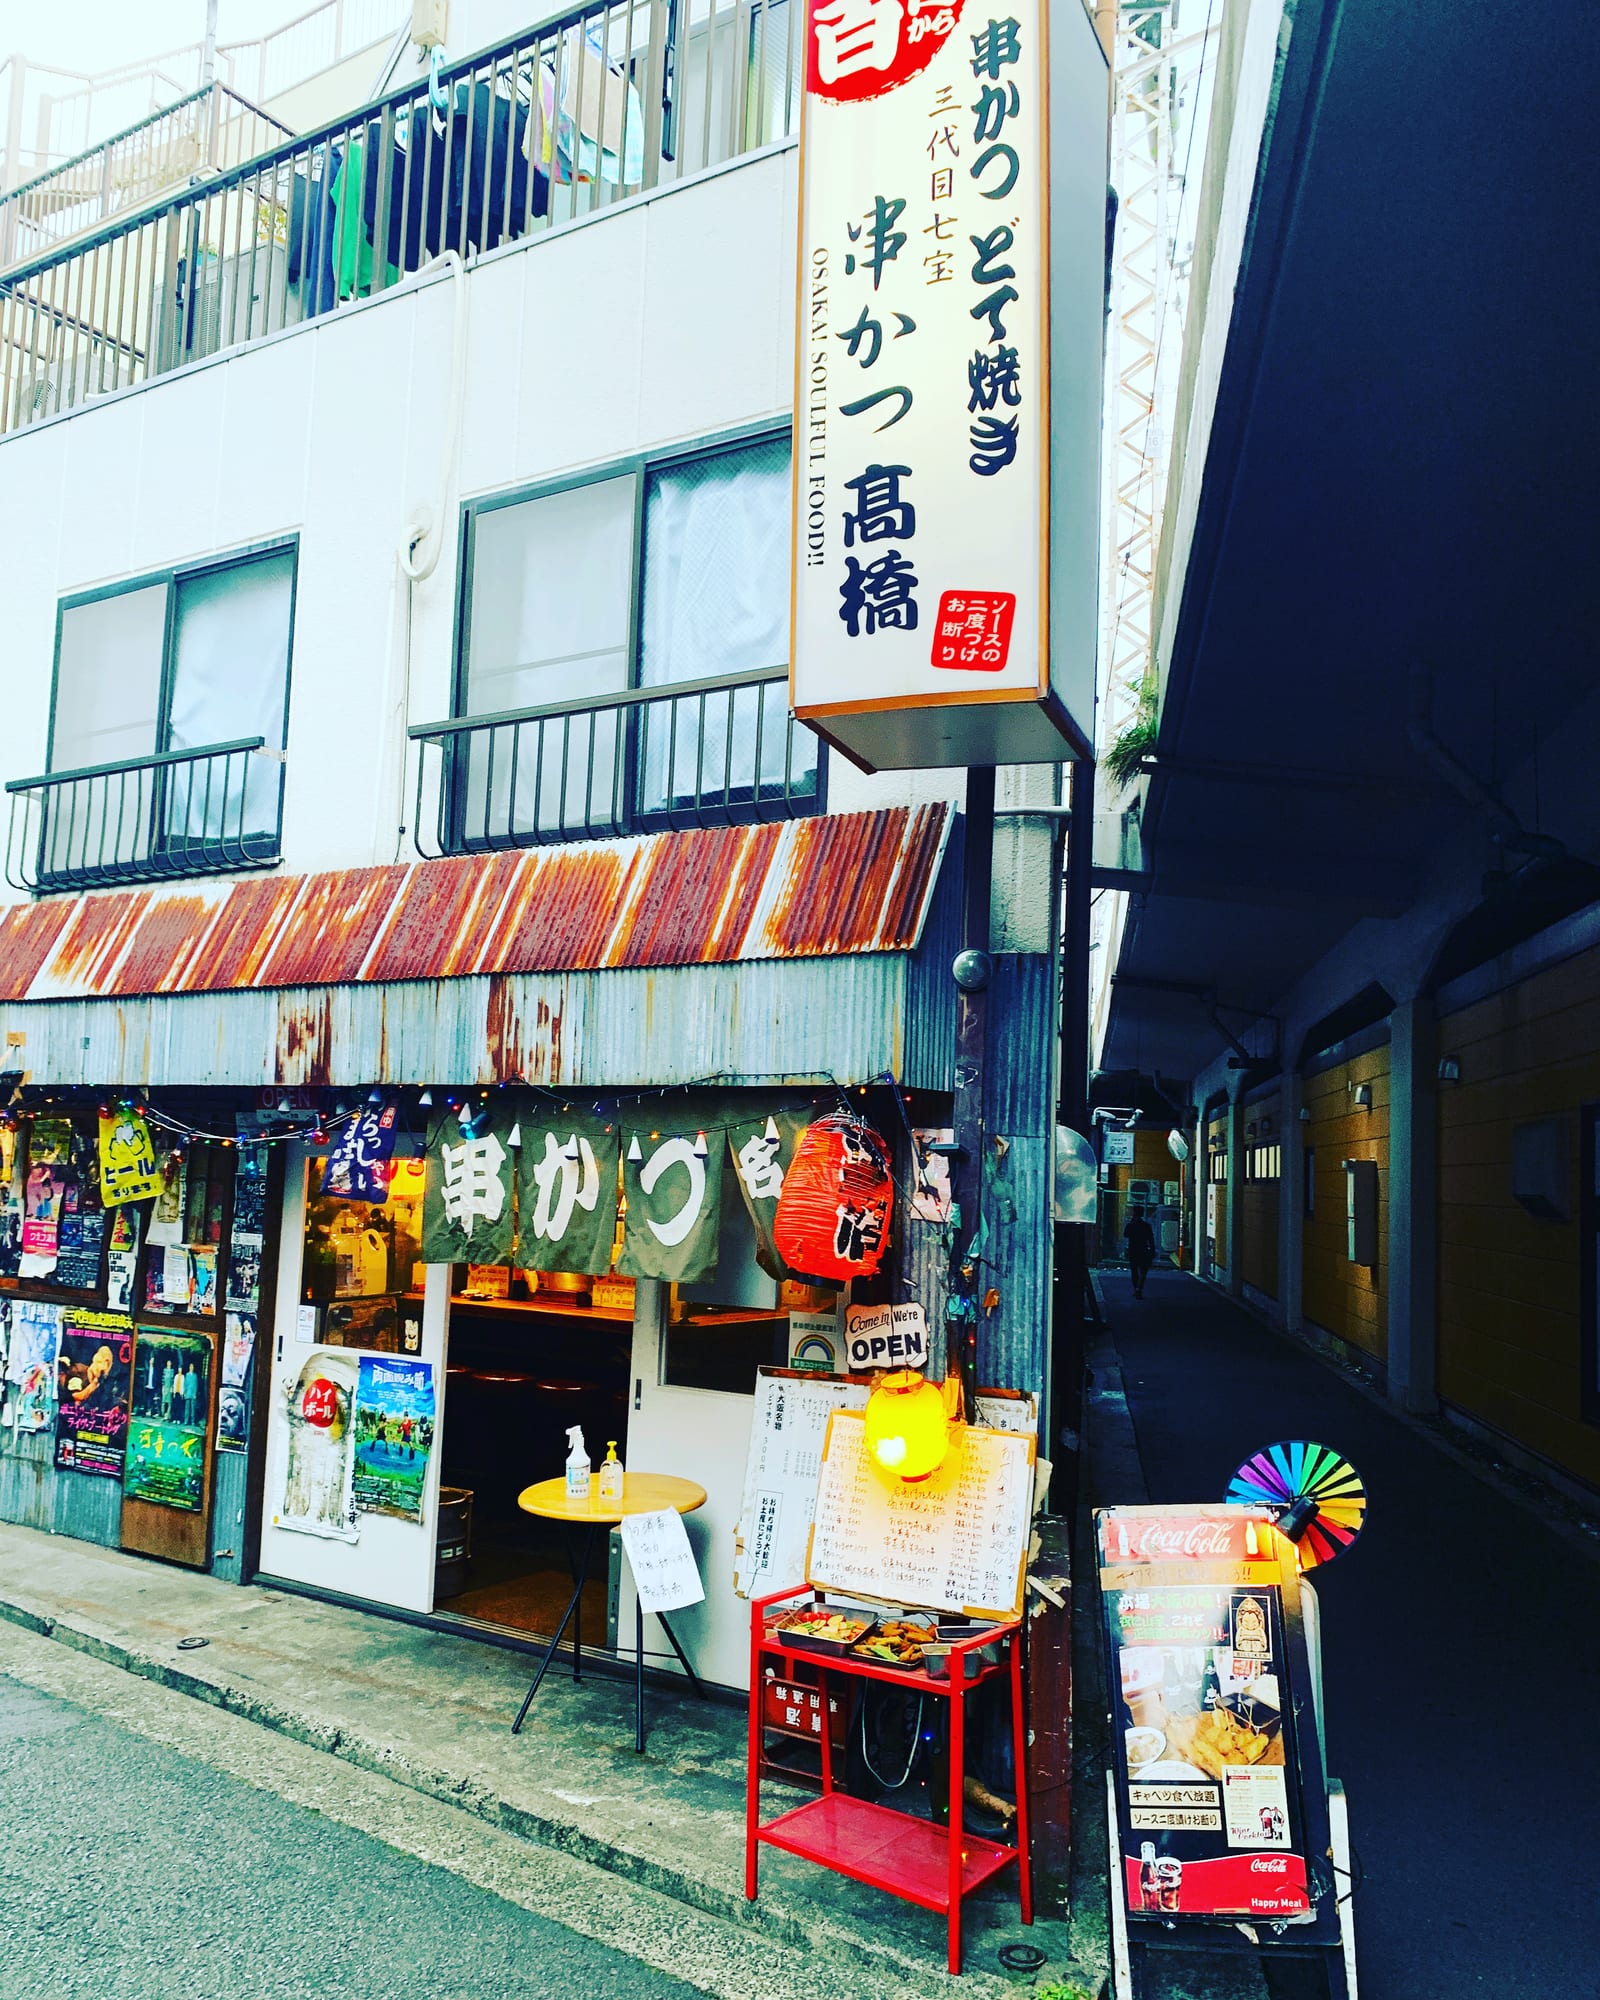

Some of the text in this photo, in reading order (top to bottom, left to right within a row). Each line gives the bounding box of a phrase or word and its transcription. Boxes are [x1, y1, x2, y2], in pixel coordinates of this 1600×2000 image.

[969, 16, 1022, 200] 串かつ
[922, 85, 962, 286] 三代目七宝
[968, 217, 1021, 477] どて焼き
[807, 247, 829, 567] OSAKA! SOULFUL FOOD!!
[941, 598, 966, 661] お断り
[961, 600, 988, 662] 二度づけ
[982, 600, 1007, 662] ソースの
[262, 1087, 311, 1108] OPEN
[849, 1315, 880, 1334] Come
[881, 1311, 891, 1326] in
[893, 1308, 919, 1323] We're
[851, 1331, 922, 1362] OPEN
[309, 1386, 333, 1402] ハイ
[304, 1402, 334, 1420] ボール
[1140, 1522, 1235, 1554] Coca-Cola
[1132, 1788, 1217, 1803] キャベツ食べ放題
[1250, 1858, 1288, 1873] Coca-Cola
[1251, 1897, 1303, 1909] Happy Meal
